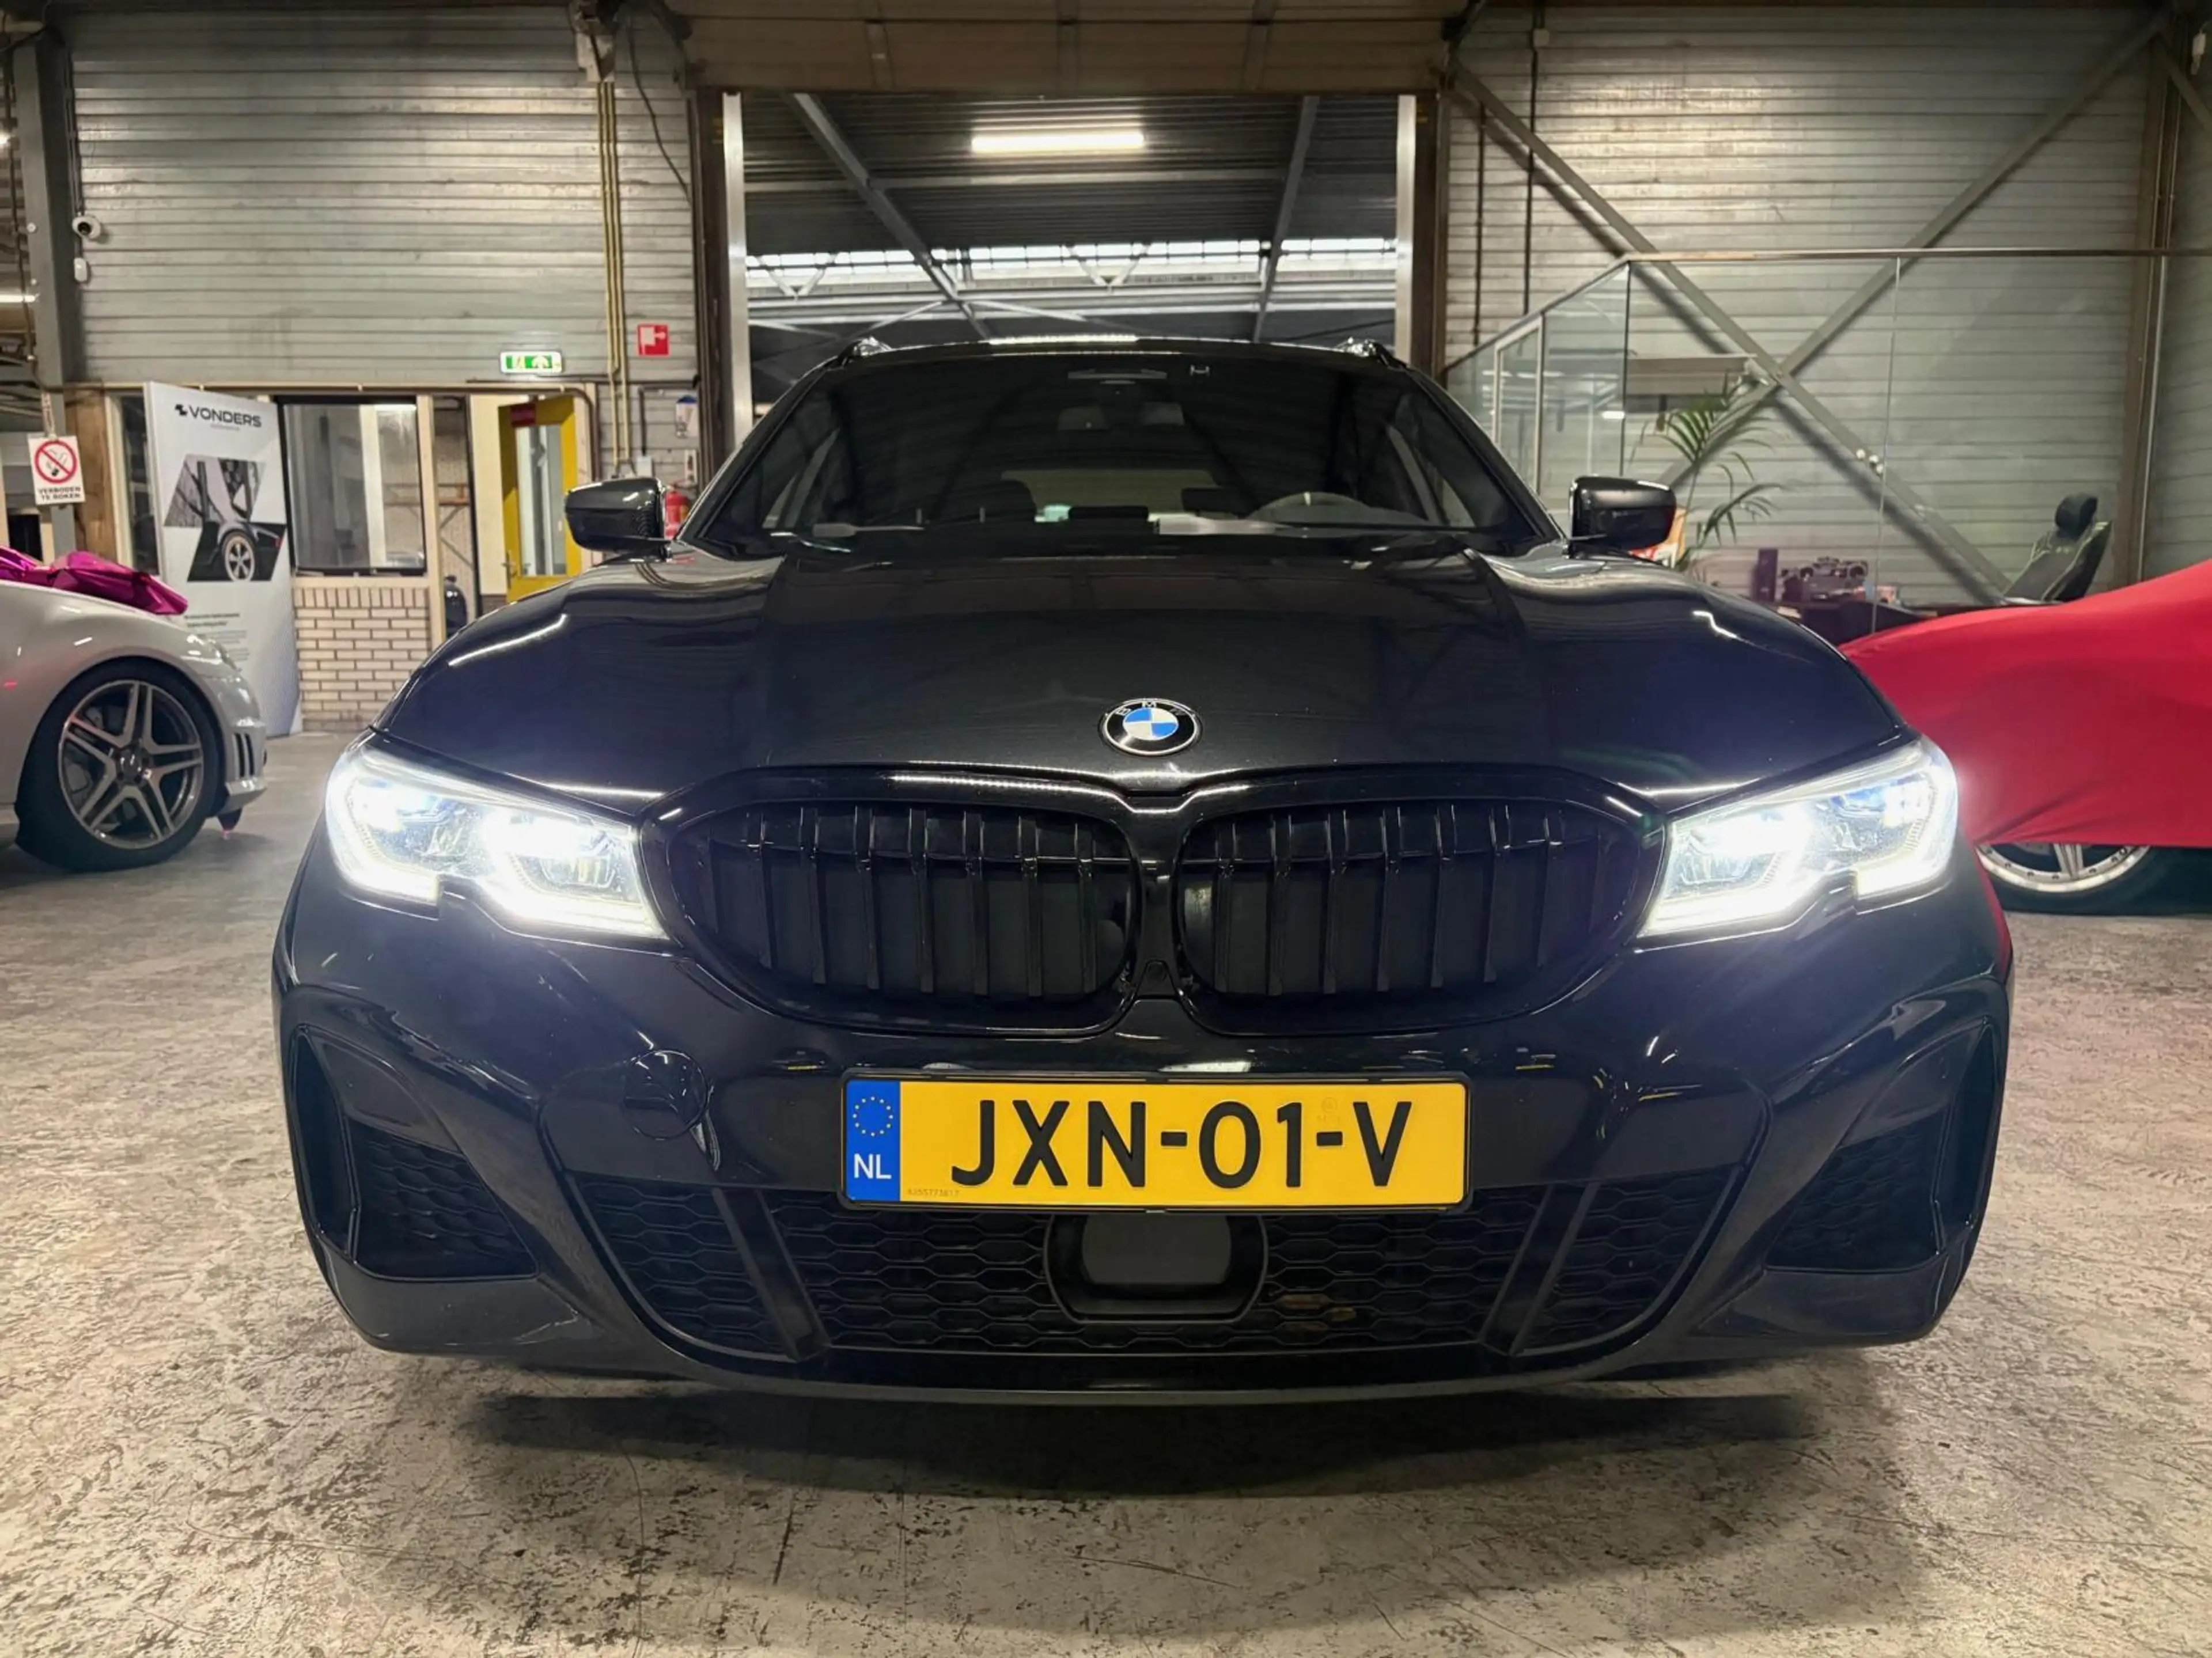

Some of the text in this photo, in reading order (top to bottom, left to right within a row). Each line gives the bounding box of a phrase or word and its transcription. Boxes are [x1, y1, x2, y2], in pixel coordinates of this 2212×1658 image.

[188, 405, 262, 428] VONDERS
[952, 1099, 1412, 1189] JXN-01-V
[854, 1154, 892, 1179] NL
